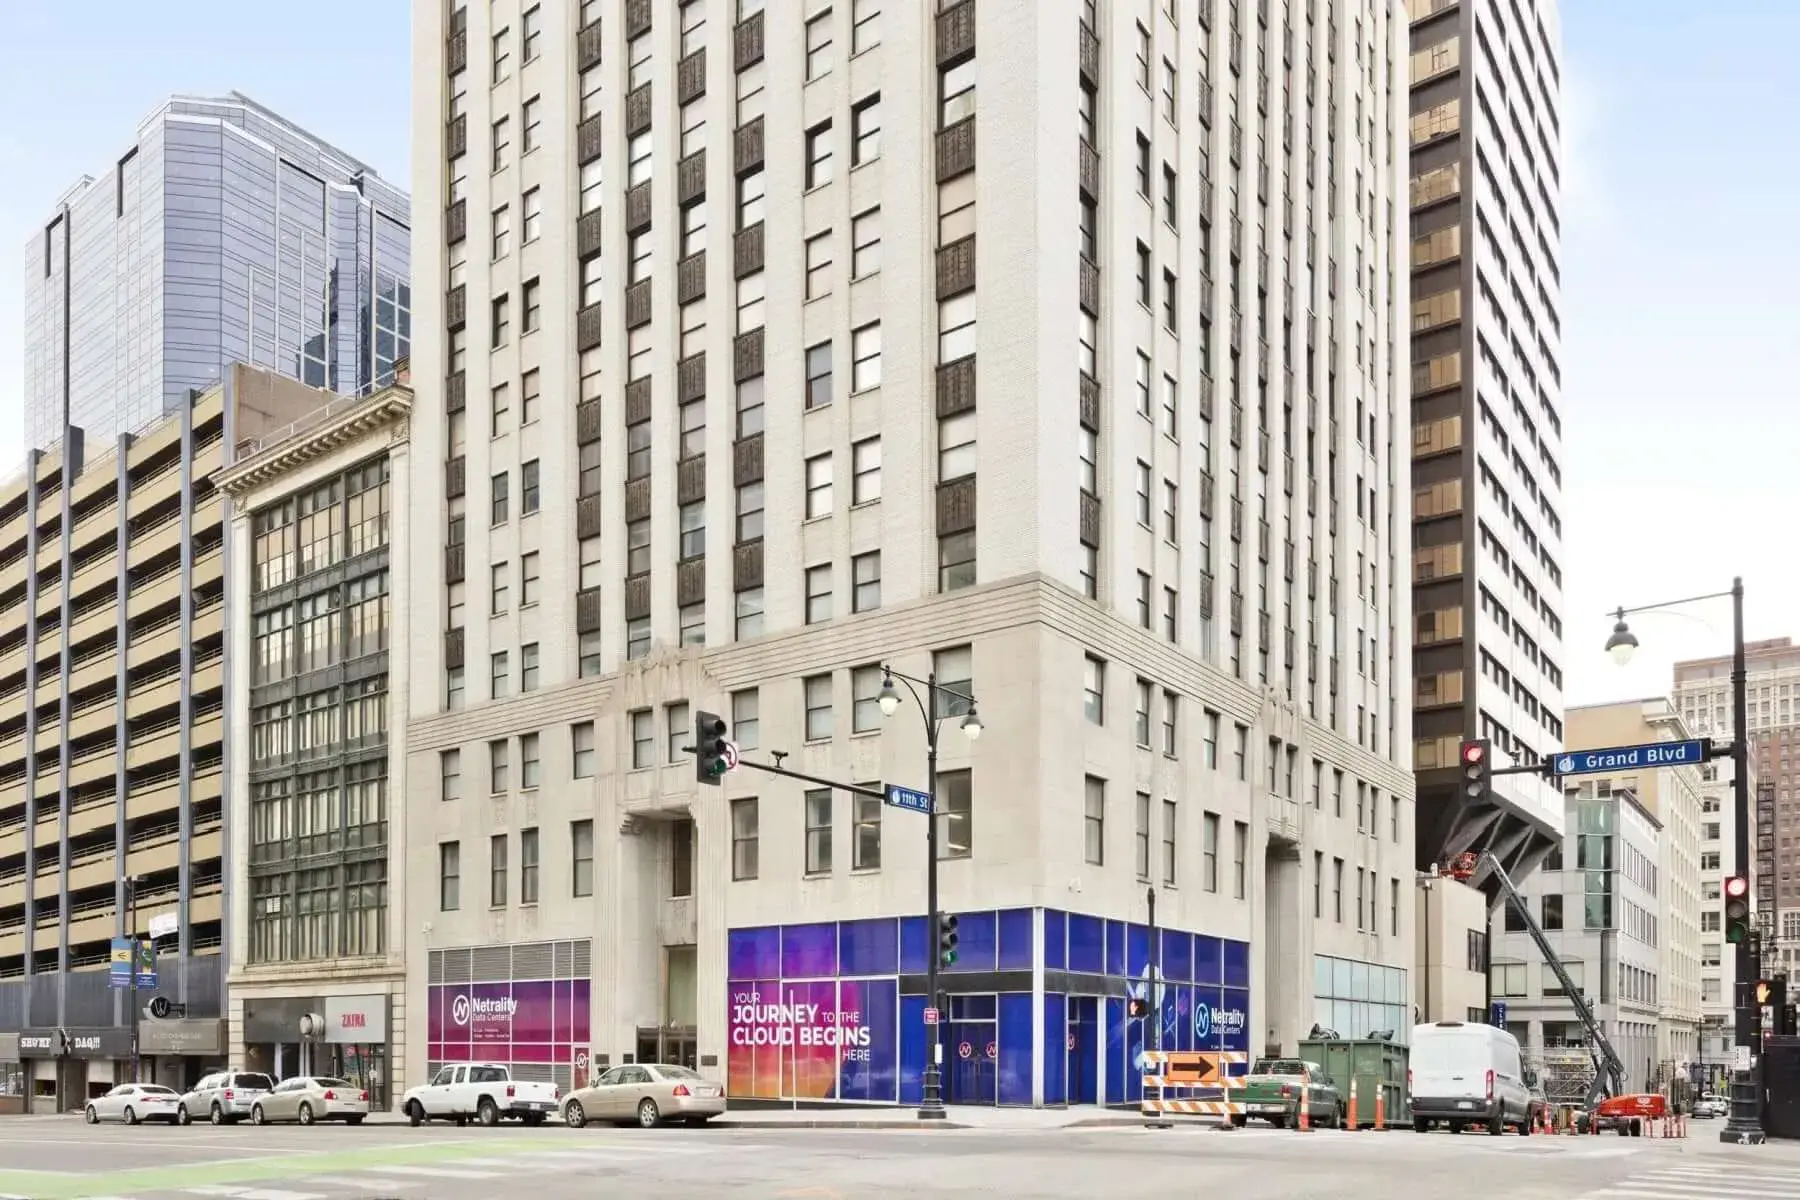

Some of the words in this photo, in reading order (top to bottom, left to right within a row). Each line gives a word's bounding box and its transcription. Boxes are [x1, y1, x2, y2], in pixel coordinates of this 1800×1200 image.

[1586, 750, 1638, 768] Grand
[1647, 745, 1686, 762] Blvd
[902, 791, 917, 806] 11th
[919, 796, 928, 809] St
[472, 997, 518, 1016] Netrality
[734, 992, 761, 1004] YOUR
[472, 1013, 486, 1021] Data
[733, 1004, 819, 1024] JOURNEY
[821, 1011, 835, 1023] TO
[841, 1011, 860, 1023] THE
[1211, 1007, 1244, 1028] Netrality
[733, 1026, 794, 1046] CLOUD
[800, 1026, 871, 1046] BEGINS
[842, 1049, 871, 1061] HERE
